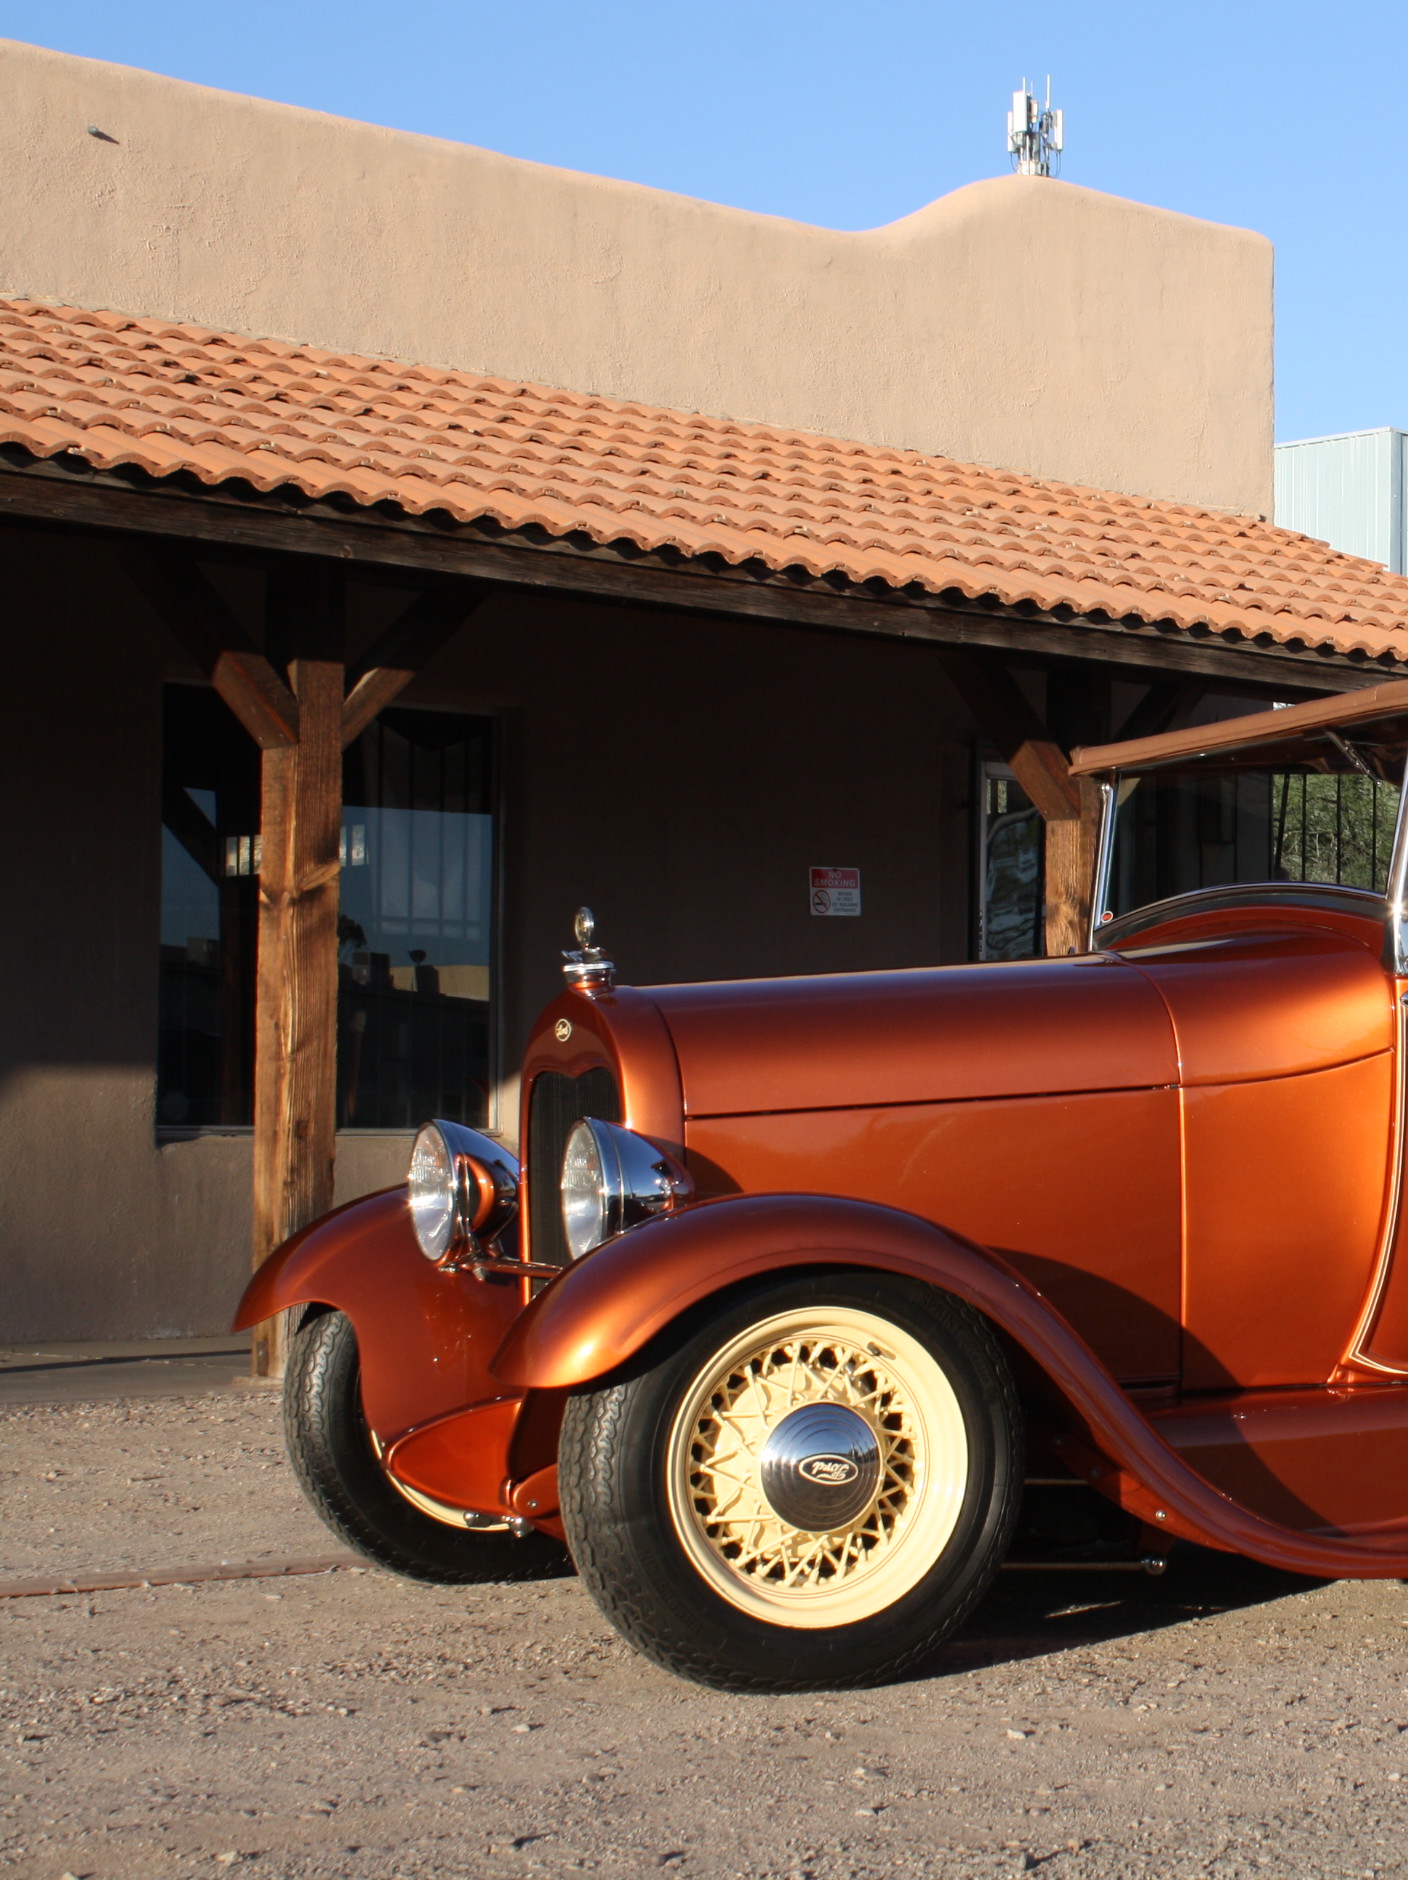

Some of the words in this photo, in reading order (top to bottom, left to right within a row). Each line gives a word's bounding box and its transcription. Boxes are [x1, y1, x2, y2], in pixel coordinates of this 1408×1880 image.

[828, 870, 842, 879] NO
[814, 878, 856, 888] SMOKING
[811, 1460, 850, 1481] Ford
